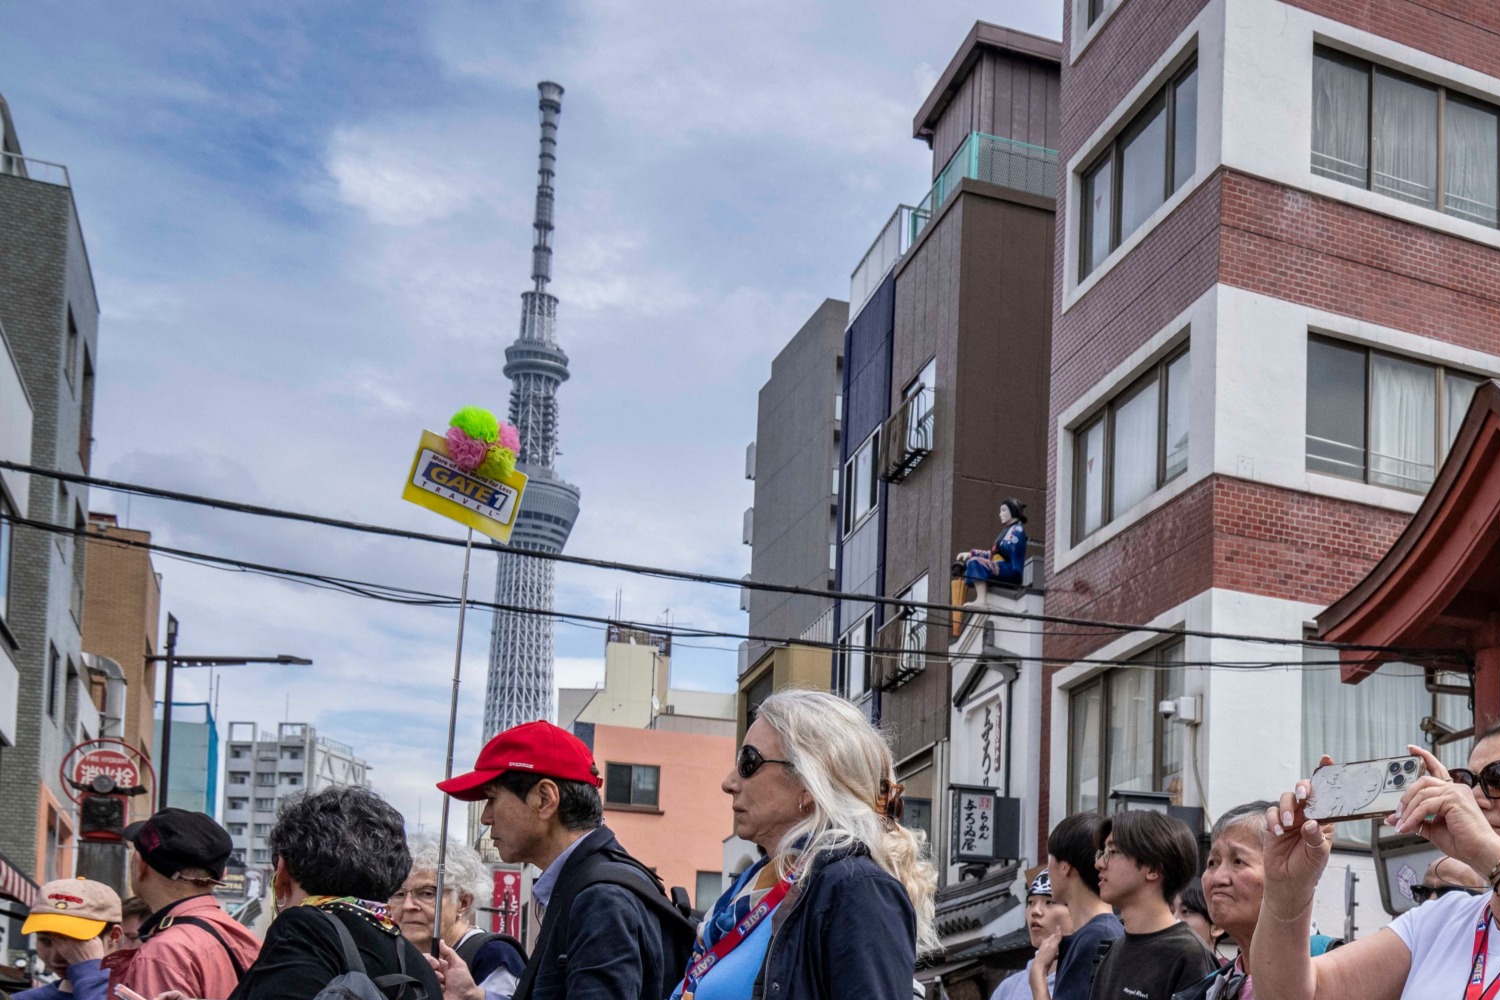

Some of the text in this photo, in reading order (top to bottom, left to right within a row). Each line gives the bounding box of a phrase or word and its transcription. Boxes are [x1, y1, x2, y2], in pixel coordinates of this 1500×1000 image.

[432, 454, 448, 466] More
[469, 470, 488, 483] World
[488, 479, 498, 488] for
[500, 484, 512, 495] Less
[422, 481, 493, 517] TRAVEL
[736, 904, 769, 937] GATE1
[687, 953, 718, 984] GATE1
